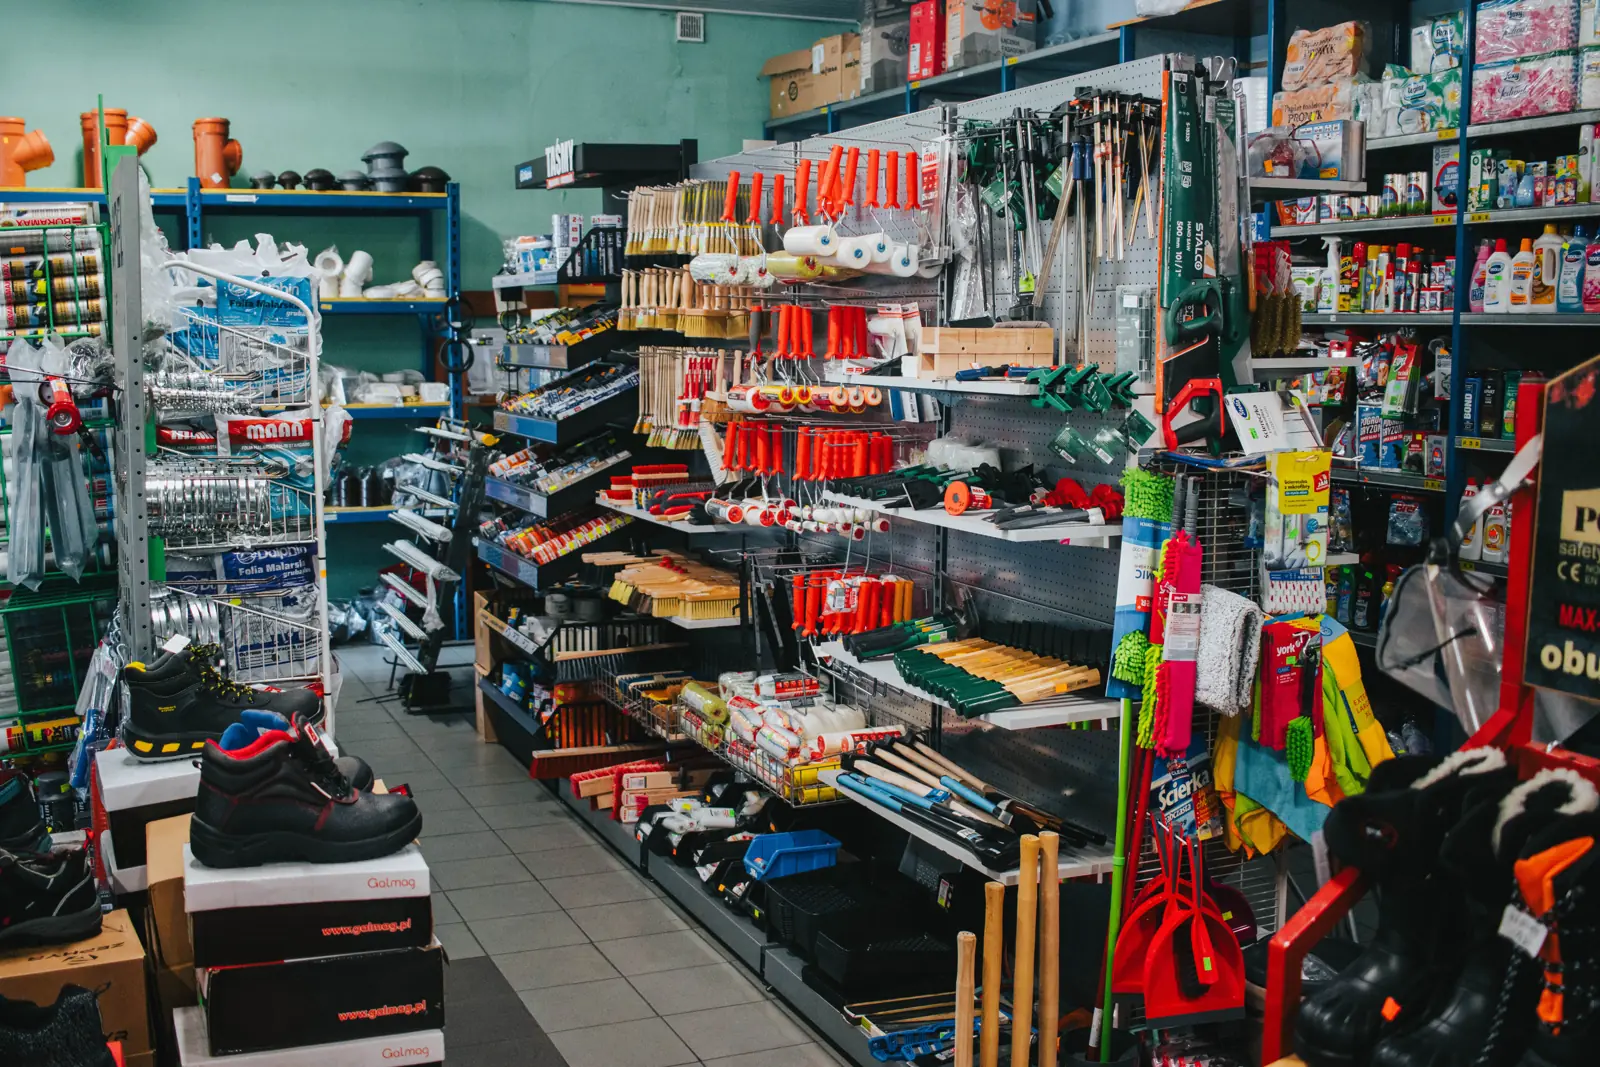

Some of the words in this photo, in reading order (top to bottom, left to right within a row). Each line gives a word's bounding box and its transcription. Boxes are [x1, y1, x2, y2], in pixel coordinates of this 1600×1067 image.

[1176, 221, 1184, 236] 500
[1194, 222, 1204, 271] STALCO
[1463, 393, 1473, 420] BOND
[247, 421, 304, 440] MAAN
[239, 565, 265, 577] Folia
[1276, 644, 1295, 657] york
[1171, 768, 1189, 777] CLEAN
[1158, 769, 1210, 811] Ścierka
[367, 877, 416, 889] Galmag
[321, 918, 412, 936] www.galmag.pl
[338, 999, 427, 1021] www.galmag.pl
[381, 1046, 430, 1060] Galmag
